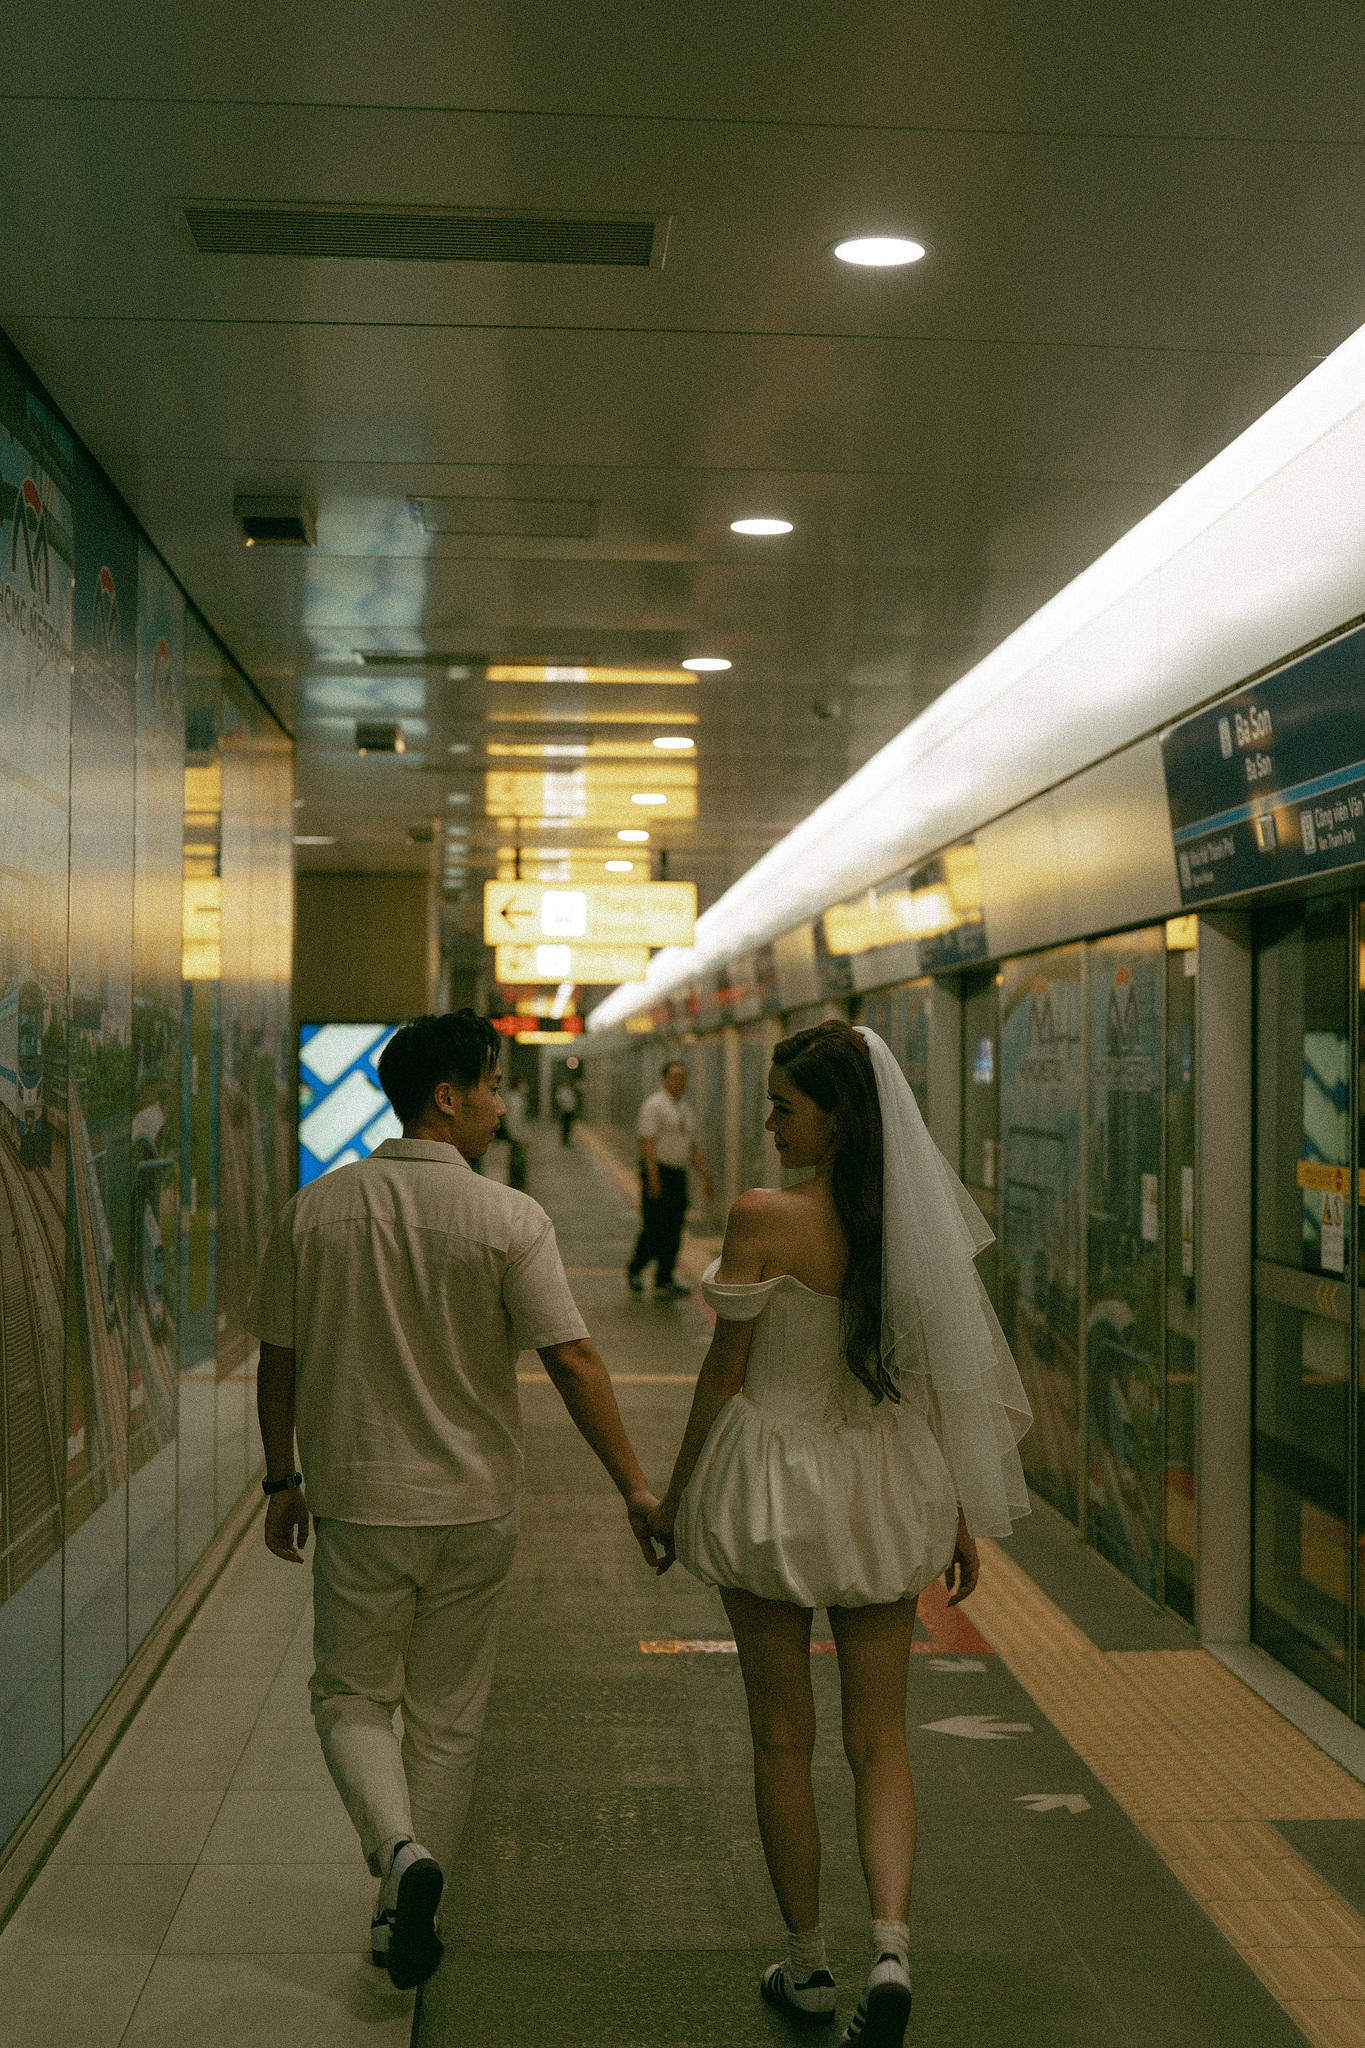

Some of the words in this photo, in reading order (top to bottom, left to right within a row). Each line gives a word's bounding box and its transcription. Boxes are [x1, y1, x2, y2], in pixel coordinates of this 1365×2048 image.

[1234, 712, 1251, 748] Ba
[1249, 705, 1273, 740] Son
[1256, 752, 1273, 777] Son
